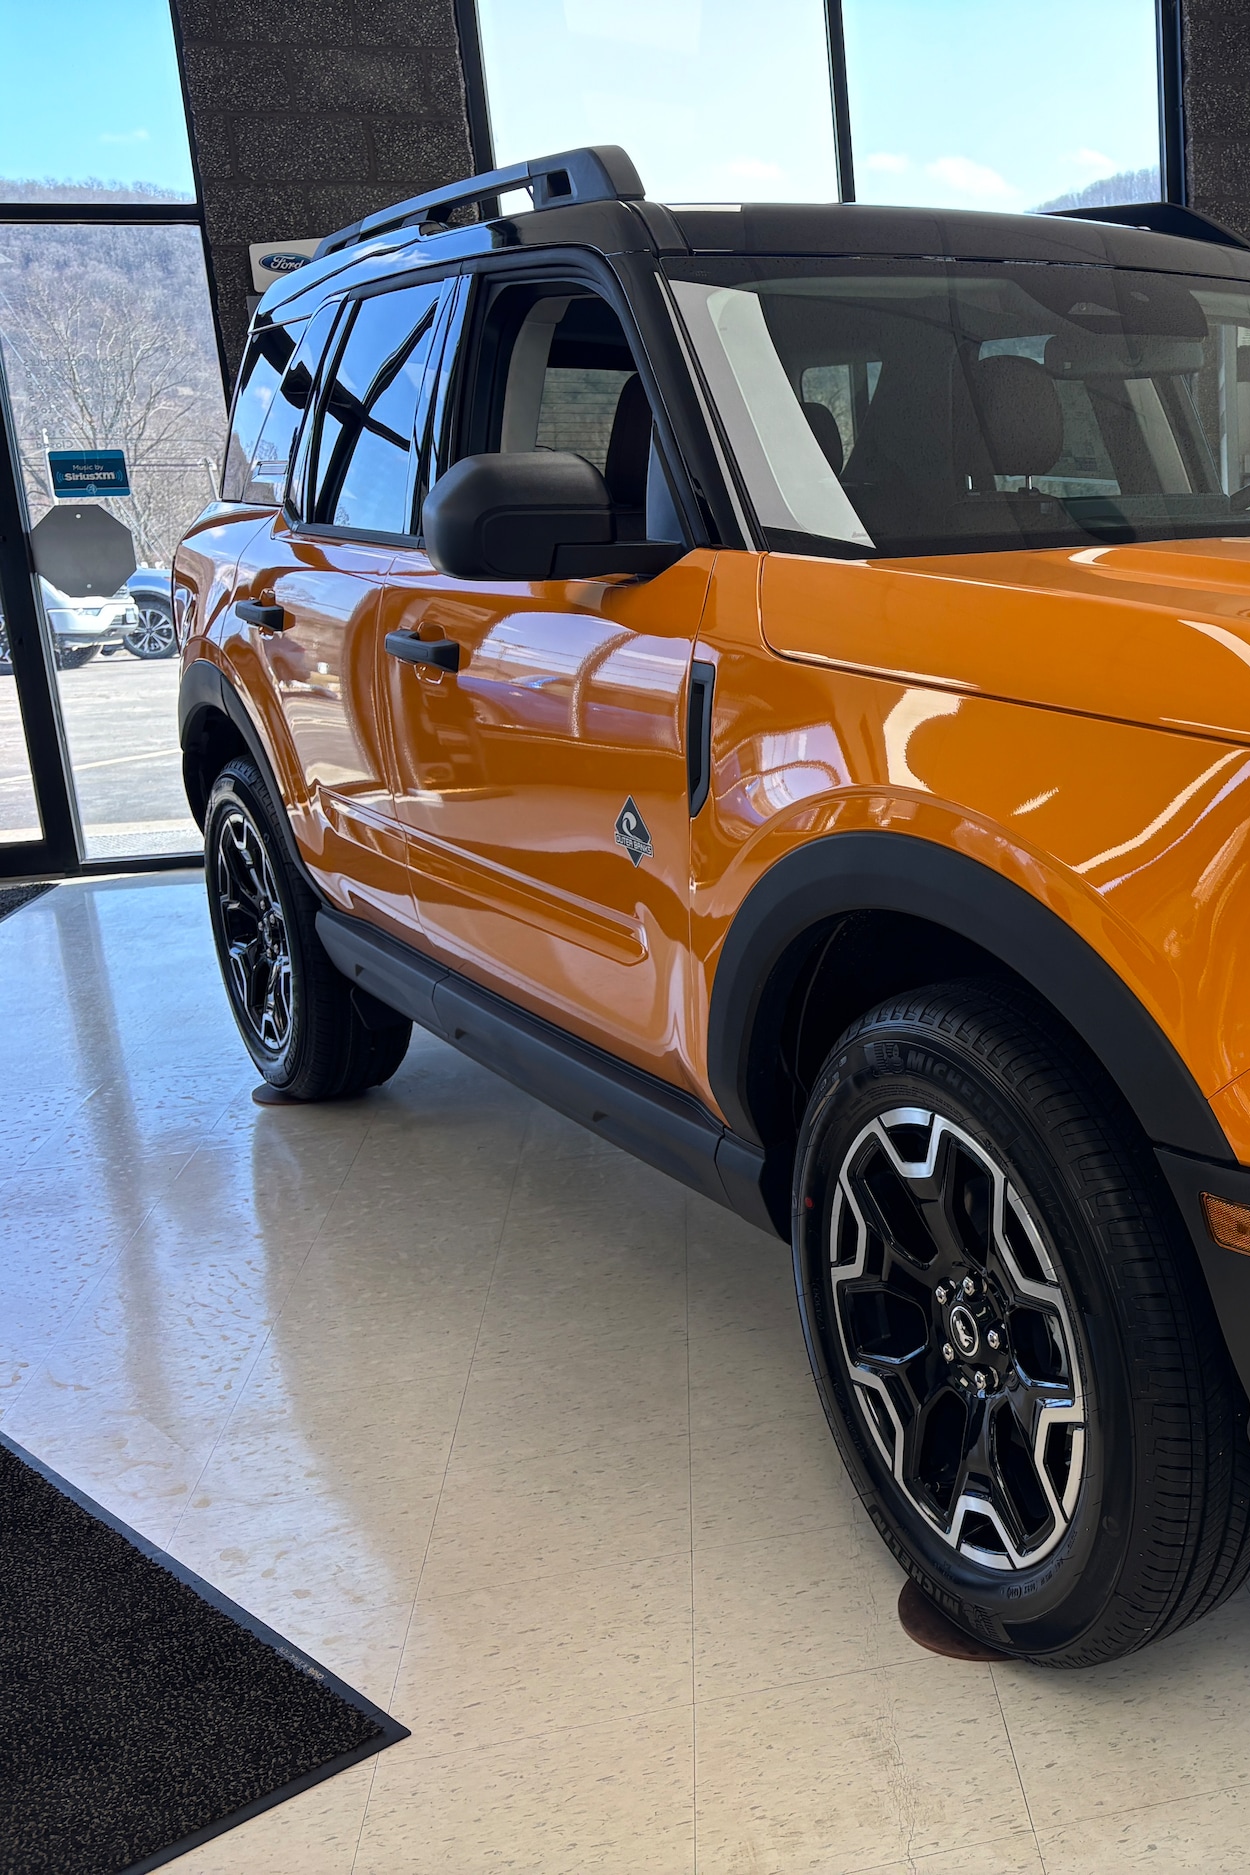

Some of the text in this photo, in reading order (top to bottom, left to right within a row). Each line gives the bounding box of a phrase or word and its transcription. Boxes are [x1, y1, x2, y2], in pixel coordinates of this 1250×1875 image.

[270, 255, 305, 270] Ford
[94, 464, 104, 472] by
[906, 1049, 1014, 1141] MICHELIN
[870, 1507, 962, 1616] MICHELIN
